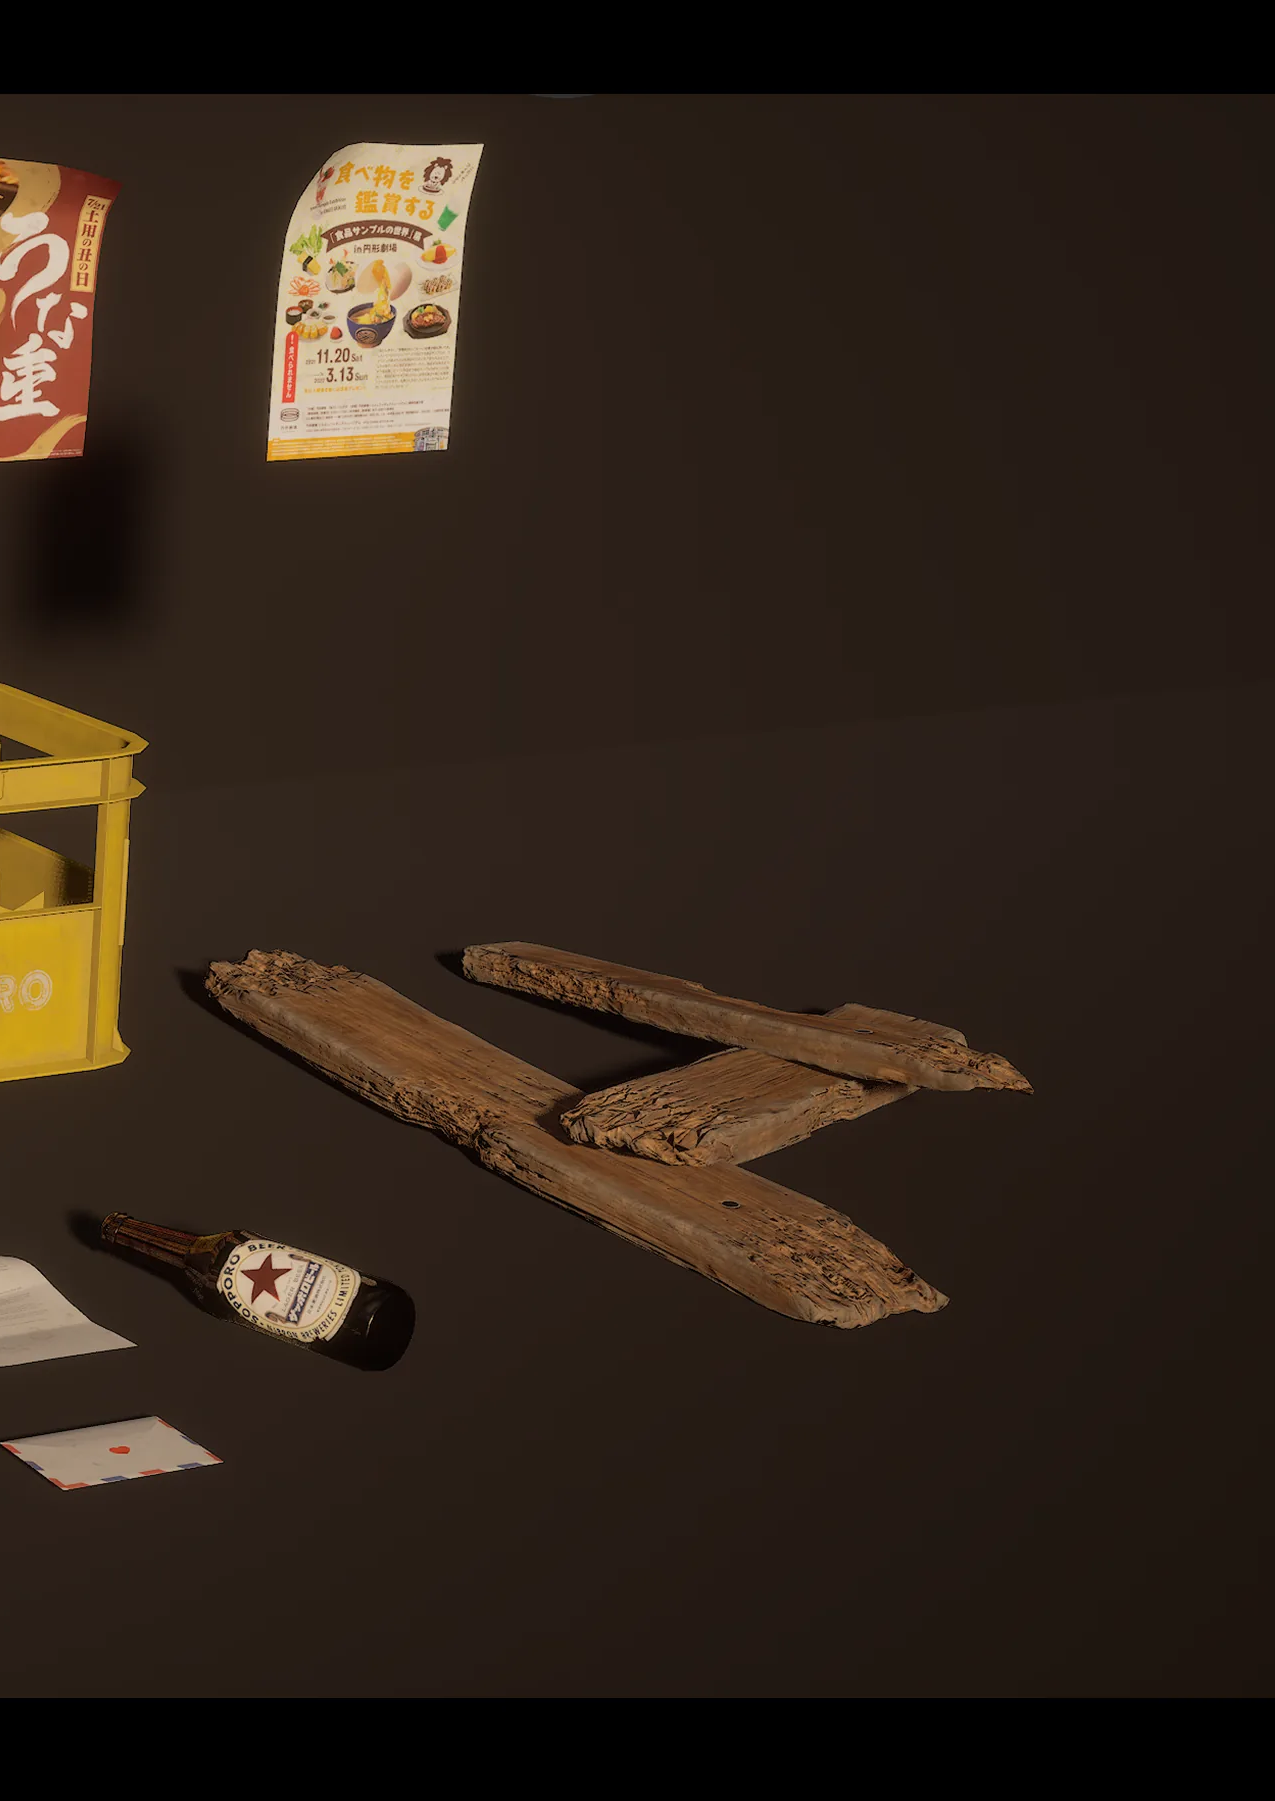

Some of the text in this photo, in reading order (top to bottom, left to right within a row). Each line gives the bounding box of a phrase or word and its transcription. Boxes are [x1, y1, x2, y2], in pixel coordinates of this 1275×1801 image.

[334, 160, 415, 190] 食べ物を
[354, 190, 436, 220] 鑑賞する
[317, 347, 350, 364] 11.20
[351, 353, 363, 362] Sat
[326, 366, 354, 382] 3.13
[355, 372, 369, 381] Sun
[222, 1254, 259, 1324] SOPPORO
[335, 1274, 351, 1307] LIMITED
